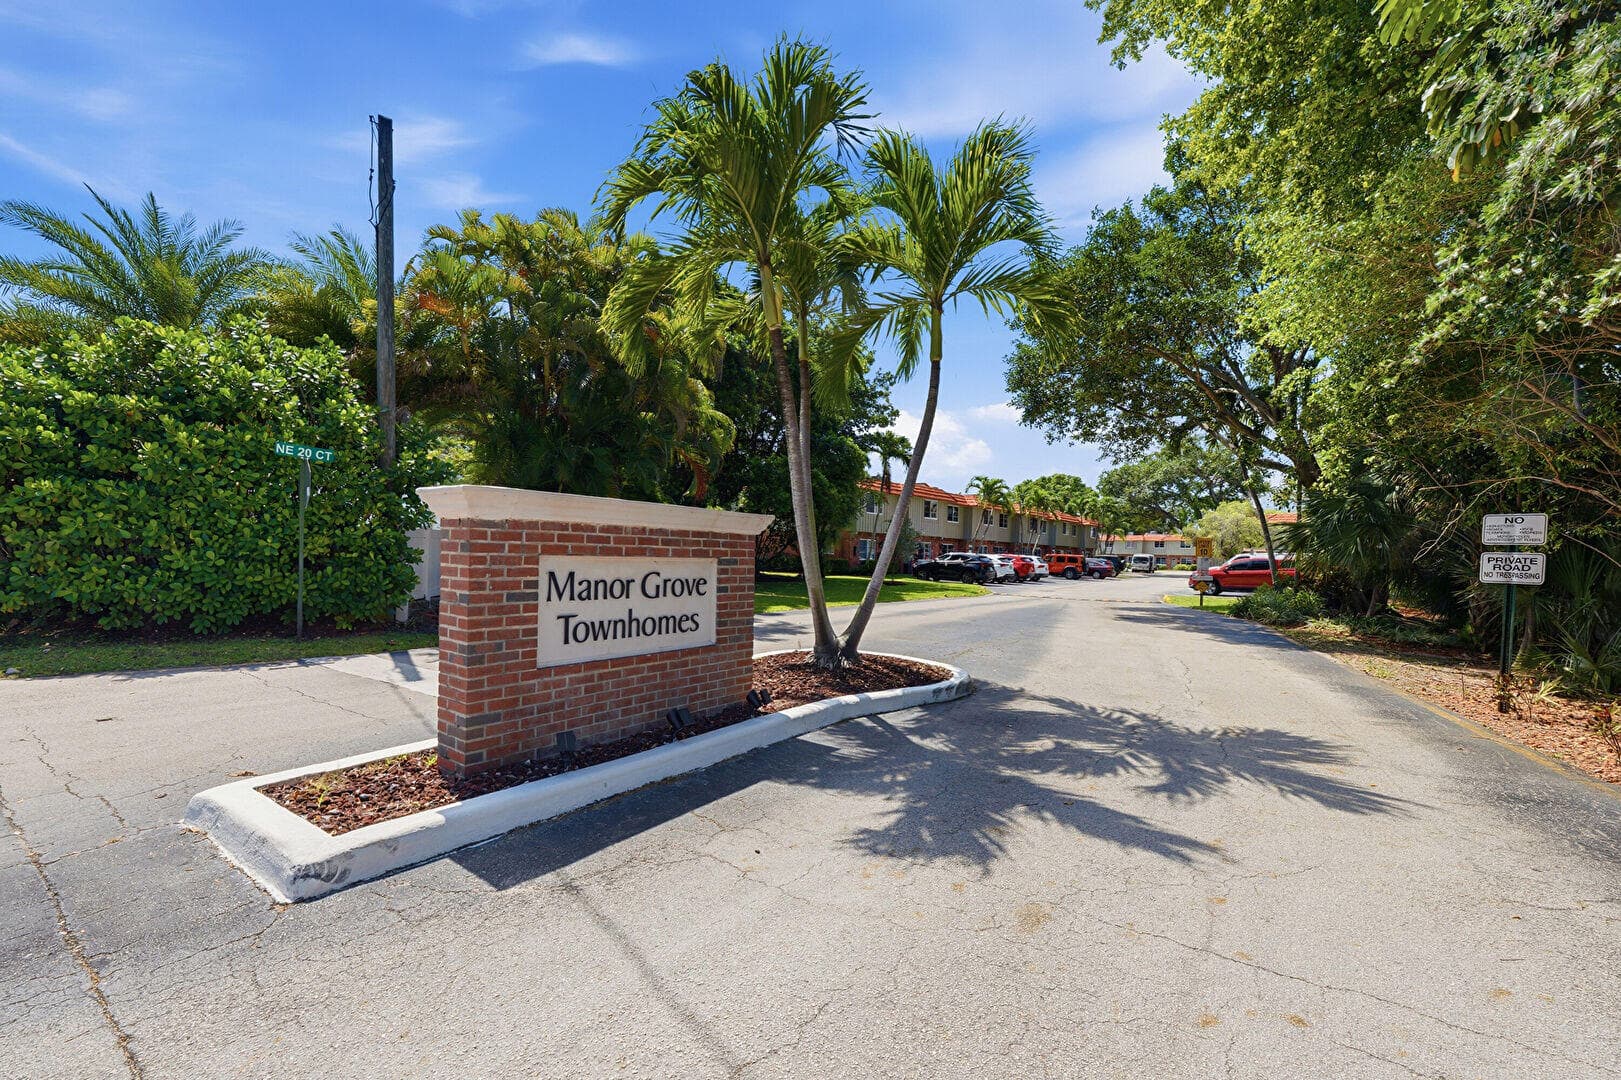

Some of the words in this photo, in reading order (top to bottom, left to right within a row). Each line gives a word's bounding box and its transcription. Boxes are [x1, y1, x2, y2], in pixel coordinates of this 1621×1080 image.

[276, 443, 294, 455] NE
[297, 447, 312, 458] 20
[315, 450, 333, 461] CT
[1504, 516, 1525, 524] NO
[1487, 557, 1538, 565] PRIVATE
[1496, 571, 1540, 580] TRESPASSING
[546, 571, 635, 602] Manor
[641, 571, 708, 599] Grove
[557, 608, 700, 645] Townhomes
